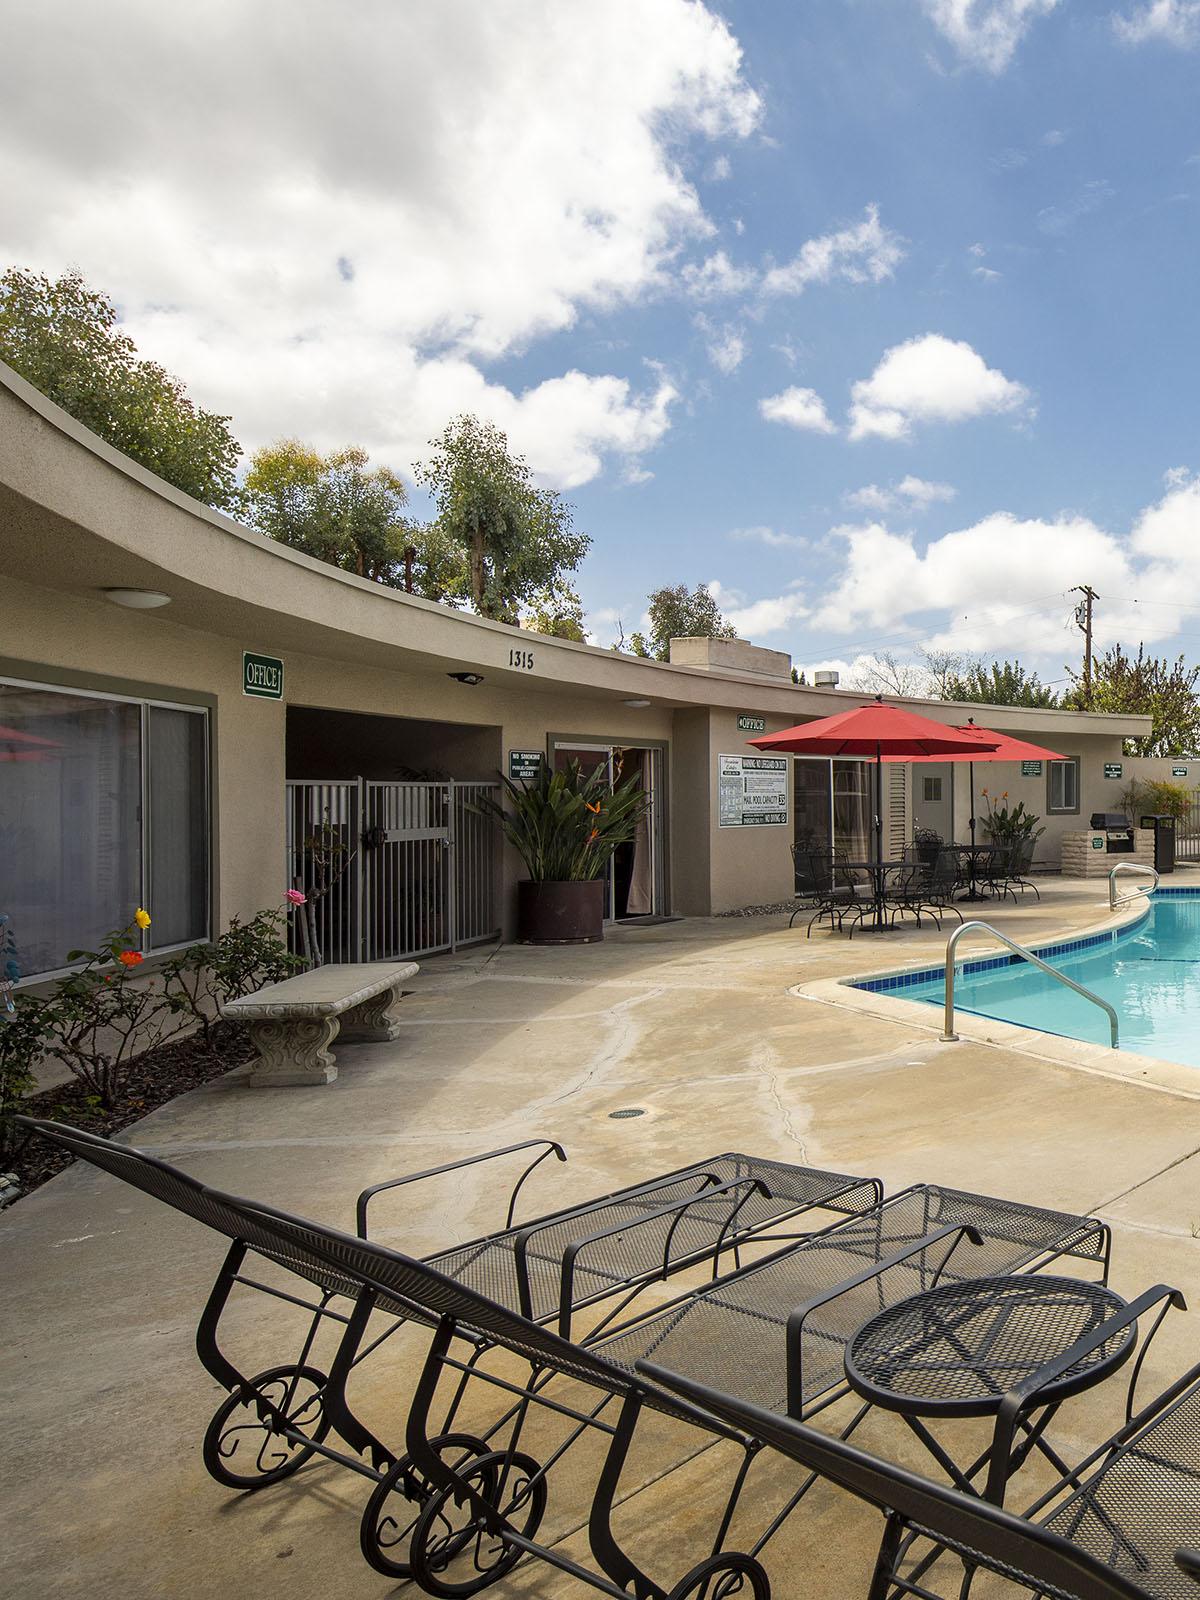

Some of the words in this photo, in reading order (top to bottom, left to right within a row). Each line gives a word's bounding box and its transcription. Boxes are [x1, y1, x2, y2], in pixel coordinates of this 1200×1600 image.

[509, 649, 534, 670] 1315
[246, 662, 278, 687] OFFICE
[743, 717, 764, 730] OFFICE
[753, 795, 762, 804] POOL
[762, 795, 778, 804] CAPACITY
